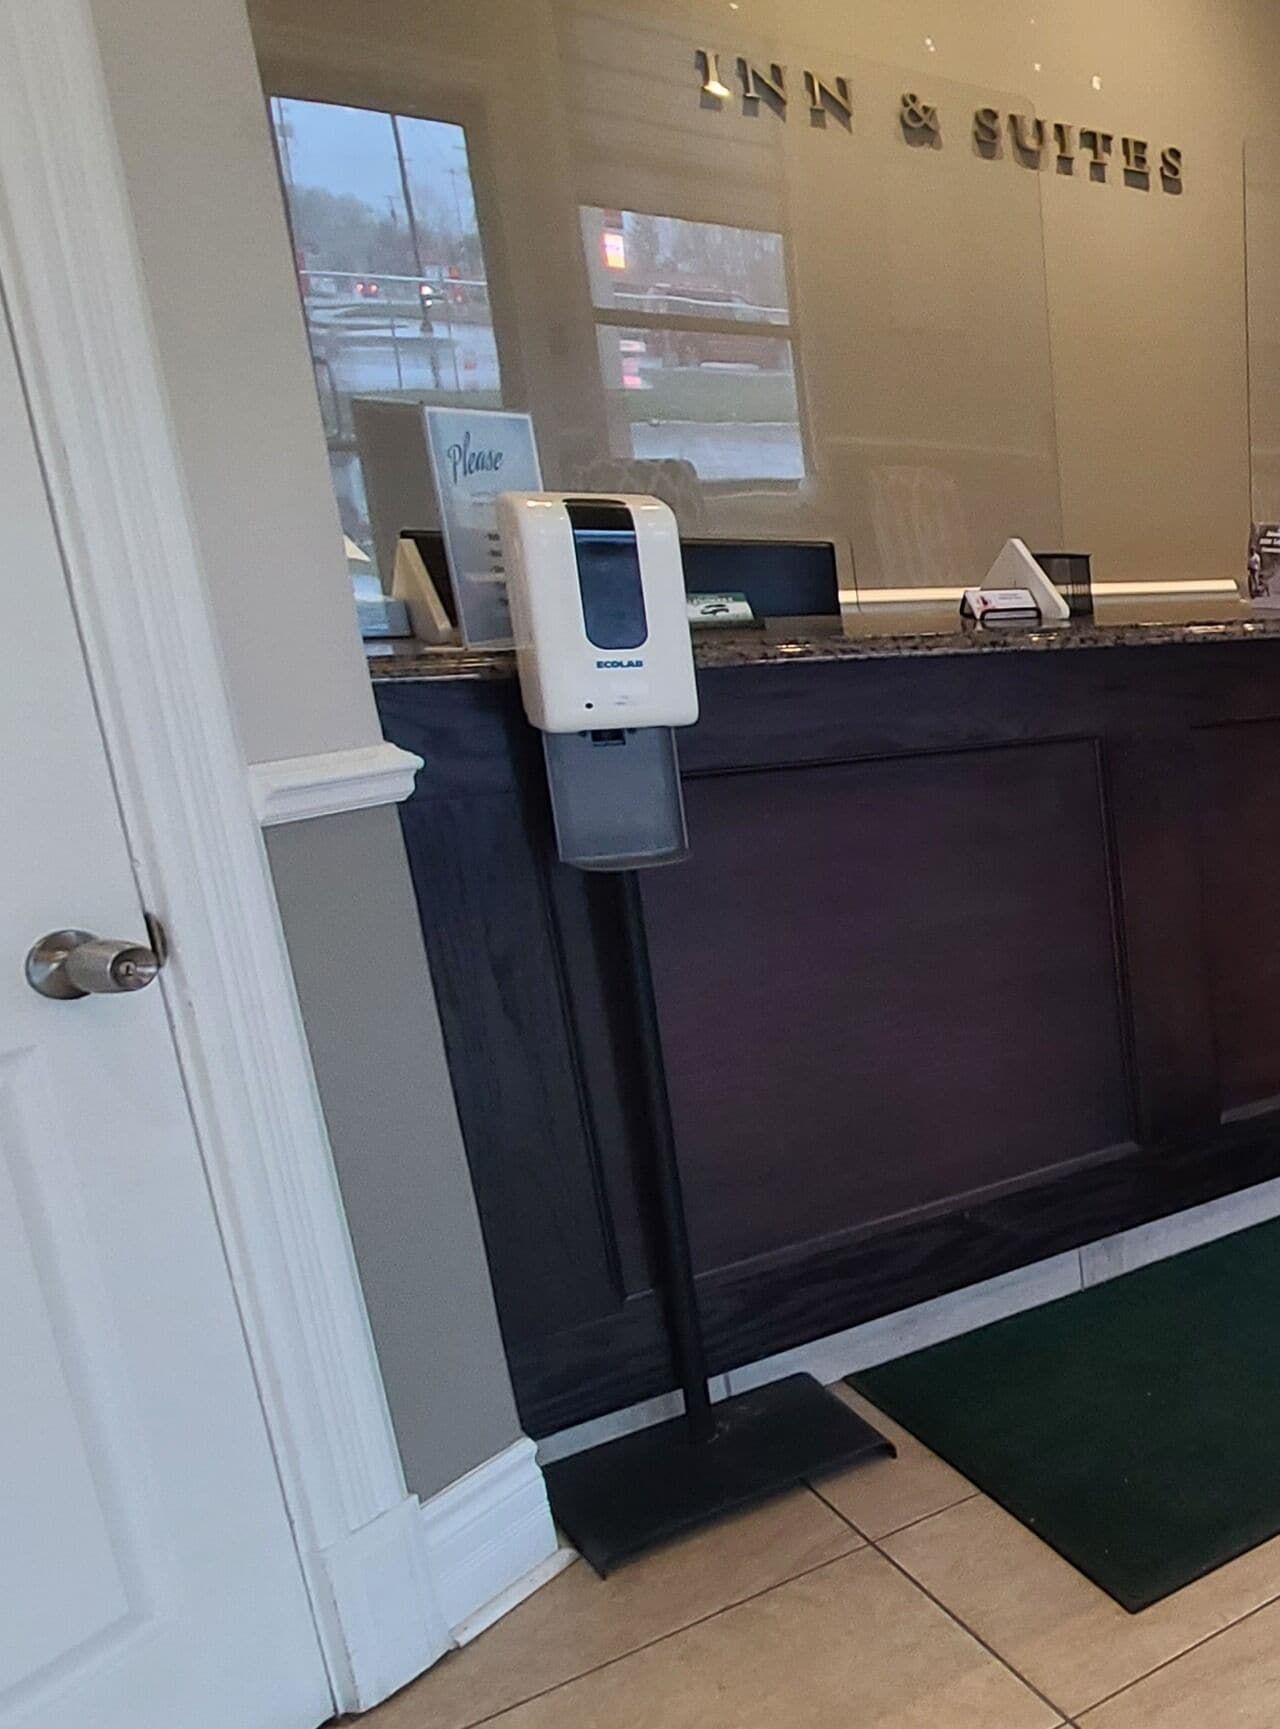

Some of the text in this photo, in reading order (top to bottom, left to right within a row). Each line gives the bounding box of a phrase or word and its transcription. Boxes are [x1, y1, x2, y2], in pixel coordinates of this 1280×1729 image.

[695, 48, 1184, 182] INN & SUITES
[447, 431, 504, 486] Please
[596, 660, 644, 669] ECOLAB
